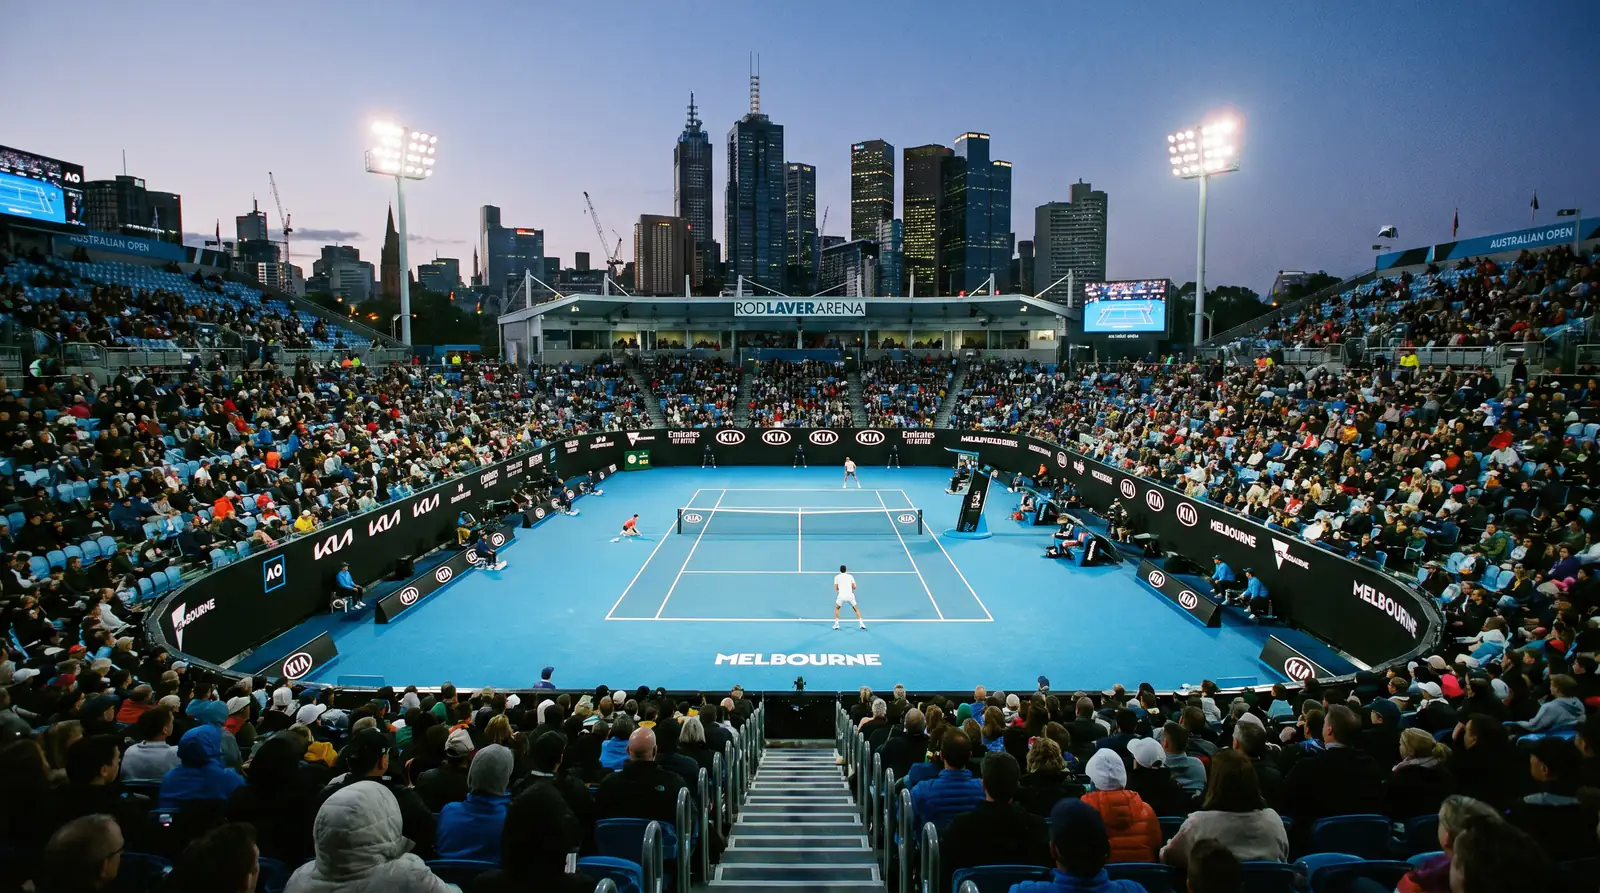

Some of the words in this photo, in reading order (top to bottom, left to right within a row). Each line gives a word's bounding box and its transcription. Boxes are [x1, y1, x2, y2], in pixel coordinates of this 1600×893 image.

[65, 172, 81, 183] AO
[1490, 231, 1545, 249] AUSTRALIAN
[1546, 227, 1573, 240] OPEN
[128, 241, 150, 252] OPEN
[668, 430, 700, 438] Emirates
[720, 433, 740, 442] KIA
[766, 433, 786, 442] KIA
[813, 433, 833, 442] KIA
[860, 433, 880, 442] KIA
[902, 430, 935, 438] Emirates
[1210, 519, 1257, 548] MELBOURNE
[266, 563, 283, 582] AO
[1353, 580, 1418, 640] MELBOURNE
[287, 656, 310, 677] KIA
[714, 652, 882, 667] MELBOURNE
